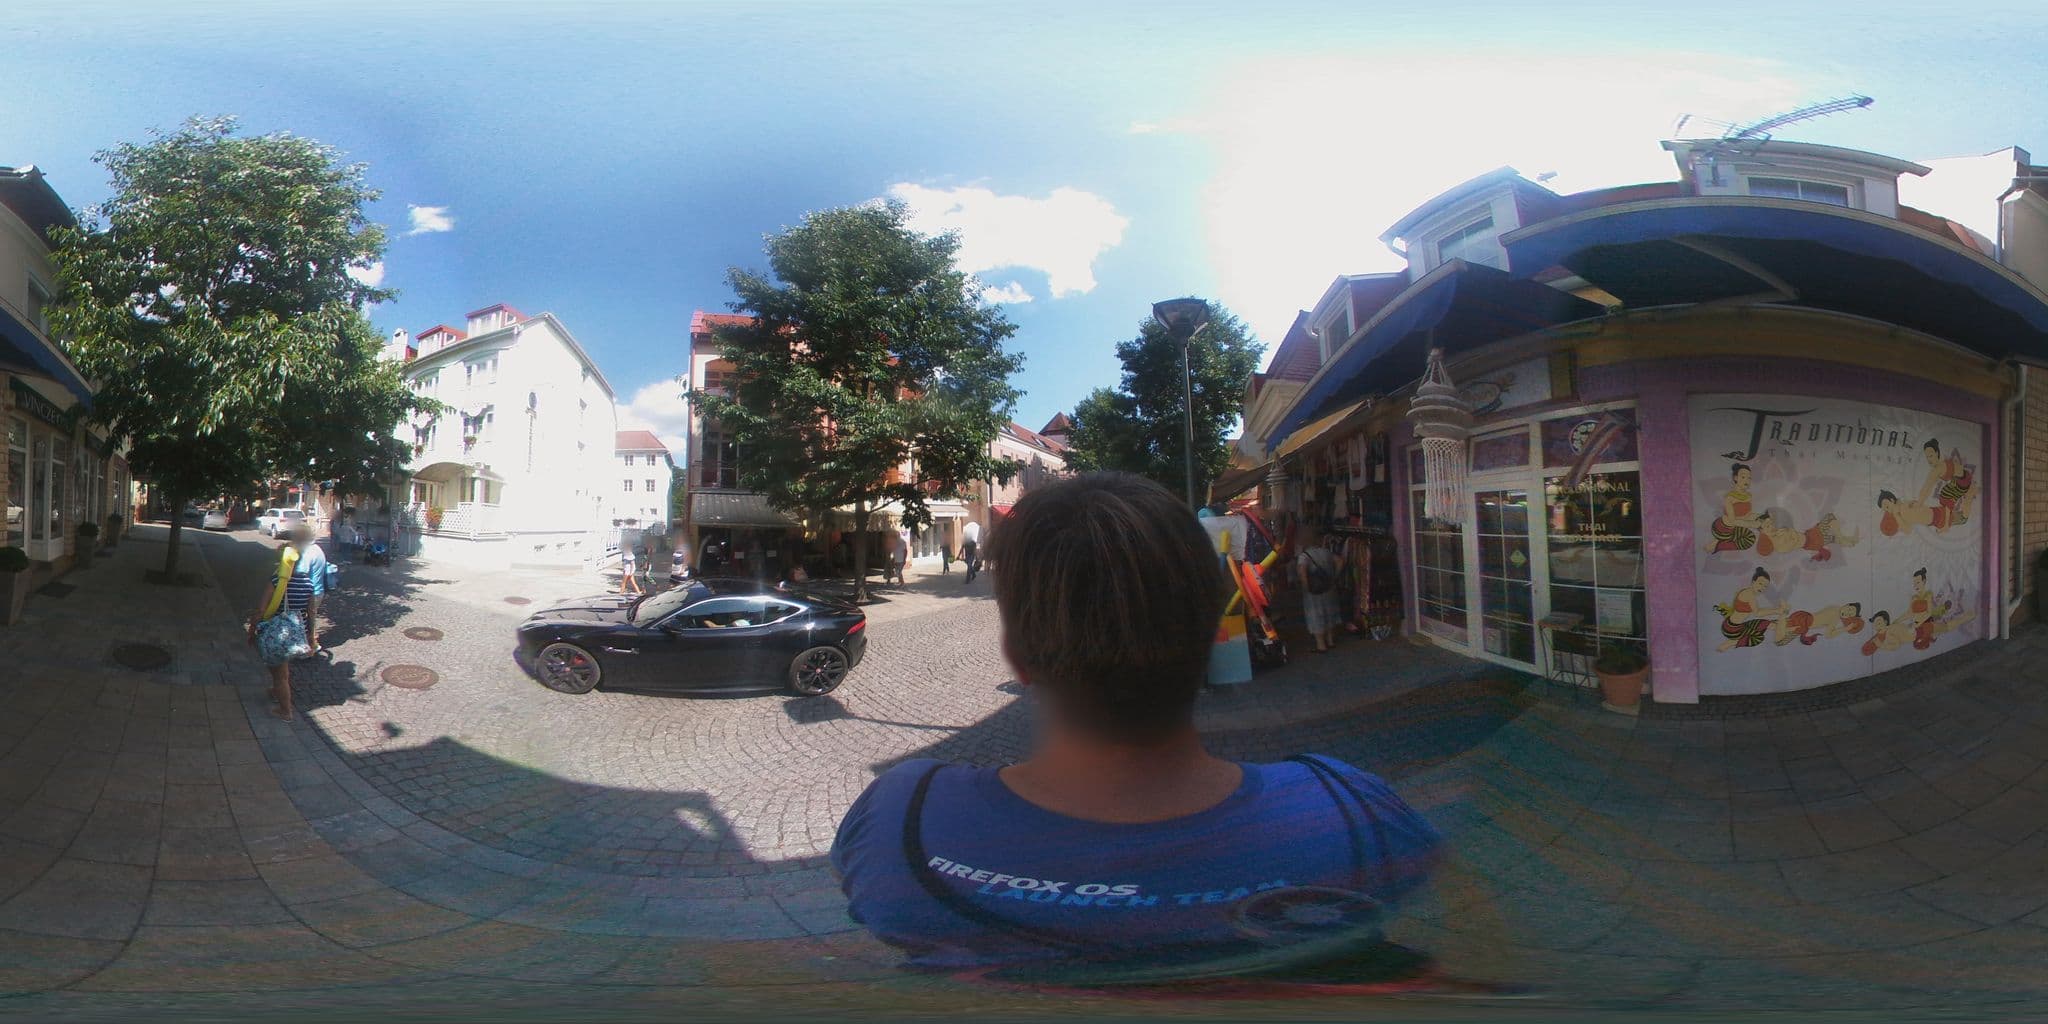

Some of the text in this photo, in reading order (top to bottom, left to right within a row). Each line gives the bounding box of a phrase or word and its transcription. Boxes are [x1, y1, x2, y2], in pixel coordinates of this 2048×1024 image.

[1708, 407, 1913, 461] TRADITIONAL
[1577, 523, 1606, 532] THAI
[928, 855, 1140, 897] FIREFOX OS
[977, 884, 1160, 907] LAUNCH
